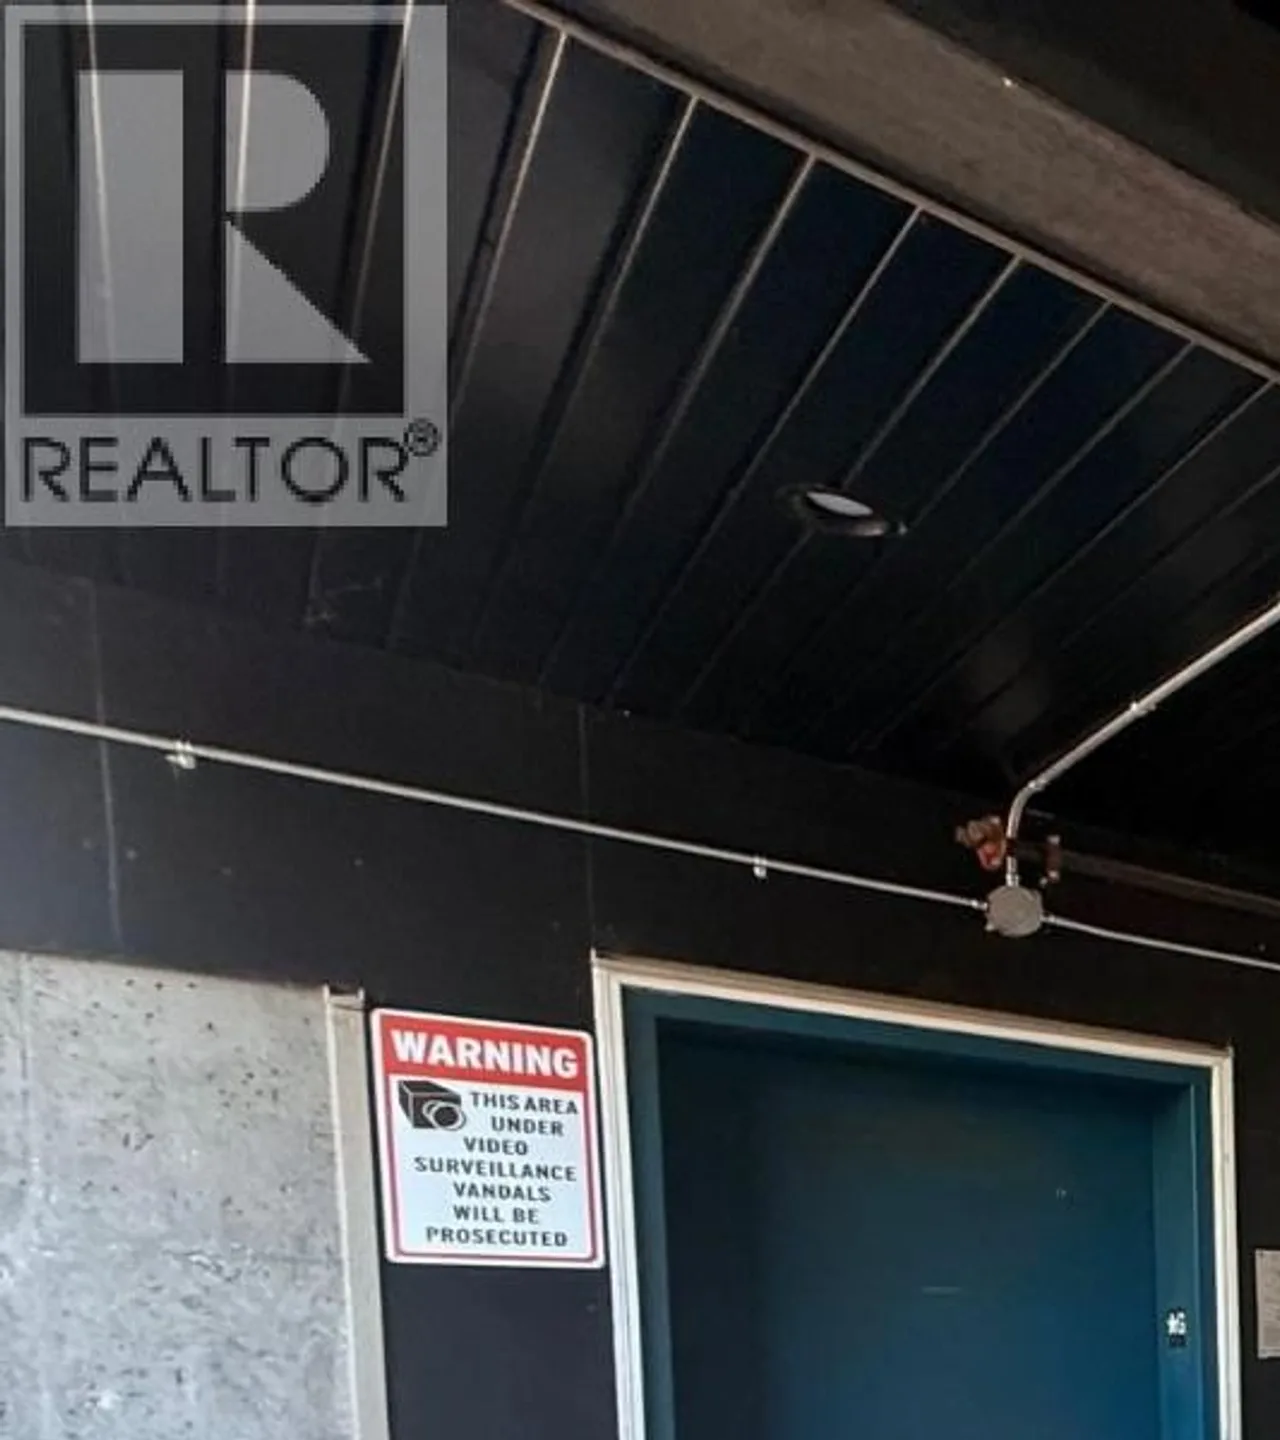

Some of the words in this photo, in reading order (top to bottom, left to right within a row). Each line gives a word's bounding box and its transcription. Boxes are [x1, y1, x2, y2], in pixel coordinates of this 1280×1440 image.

[389, 1029, 579, 1079] WARNING
[491, 1116, 564, 1135] UNDER
[463, 1137, 528, 1155] VIDEO
[414, 1156, 577, 1182] SURVEILLANCE
[453, 1182, 552, 1202] VANDALS
[453, 1205, 505, 1223] WILL
[512, 1207, 540, 1225] BE
[425, 1226, 568, 1247] PROSECUTED
